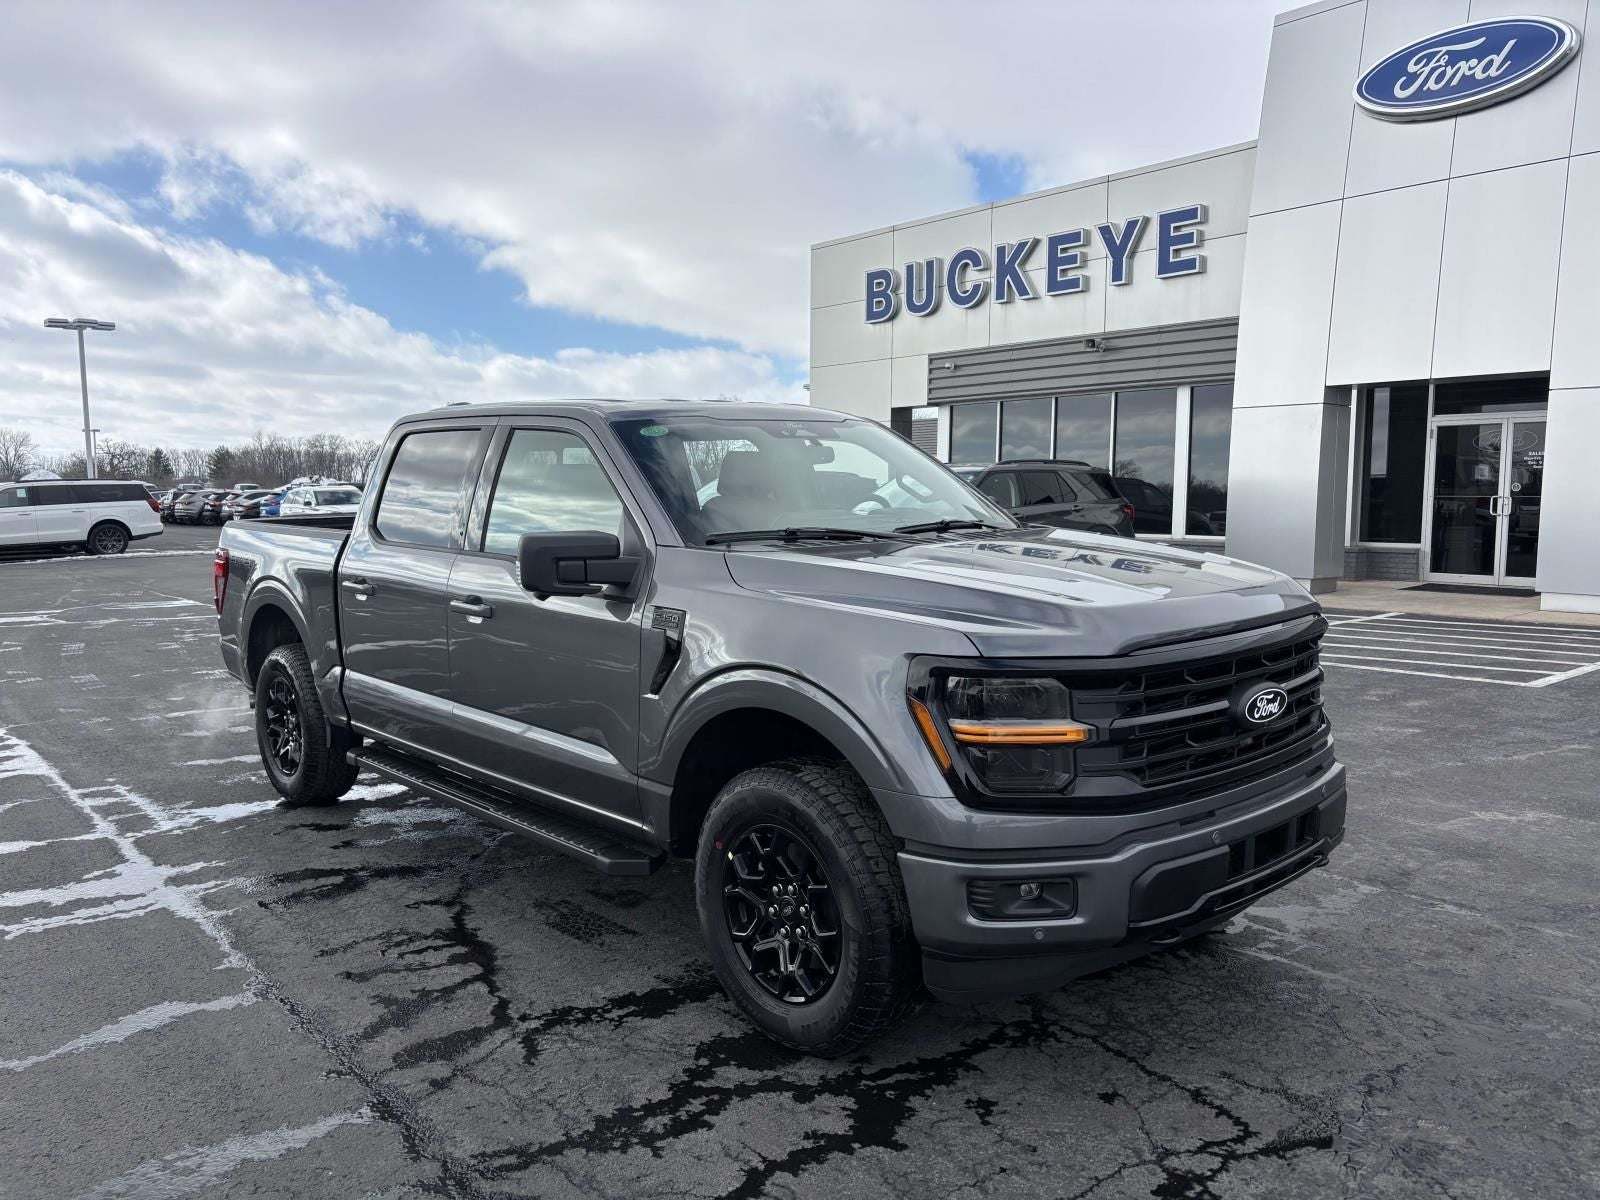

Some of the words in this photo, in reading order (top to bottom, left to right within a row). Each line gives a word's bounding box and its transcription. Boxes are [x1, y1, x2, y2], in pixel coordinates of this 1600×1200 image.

[1394, 36, 1519, 98] Ford
[864, 203, 1208, 325] BUCKEYE
[1254, 693, 1281, 719] Ford
